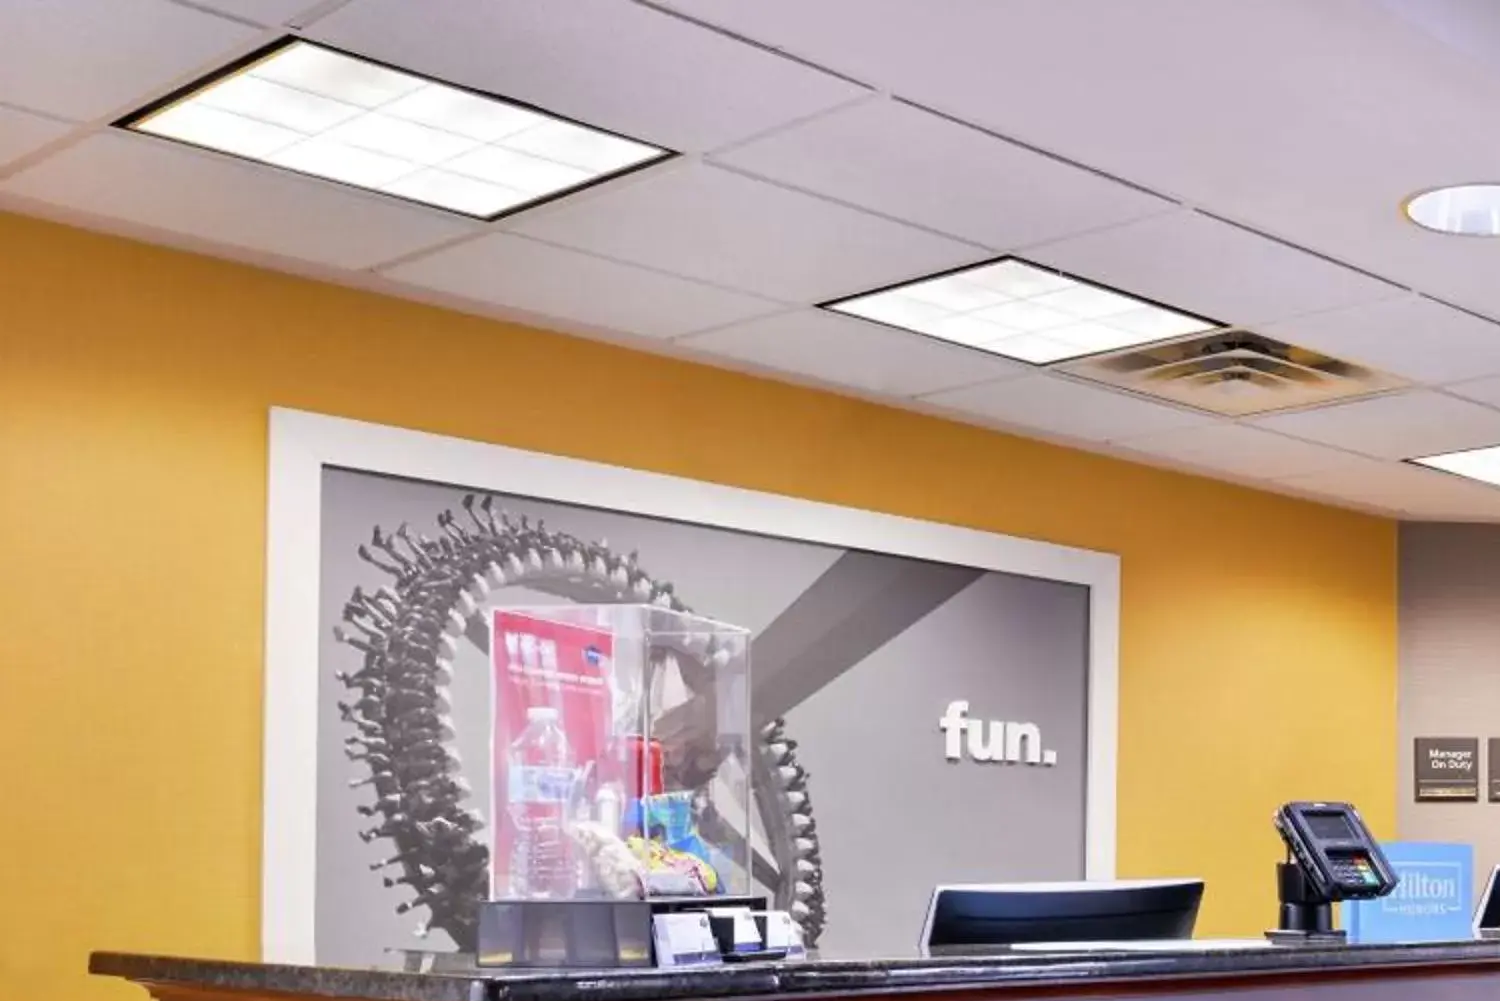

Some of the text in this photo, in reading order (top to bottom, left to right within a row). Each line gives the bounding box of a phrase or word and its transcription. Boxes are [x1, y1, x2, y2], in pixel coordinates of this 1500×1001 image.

[940, 699, 1057, 764] fun.
[1429, 748, 1472, 761] Manager
[1431, 759, 1473, 771] On Duty
